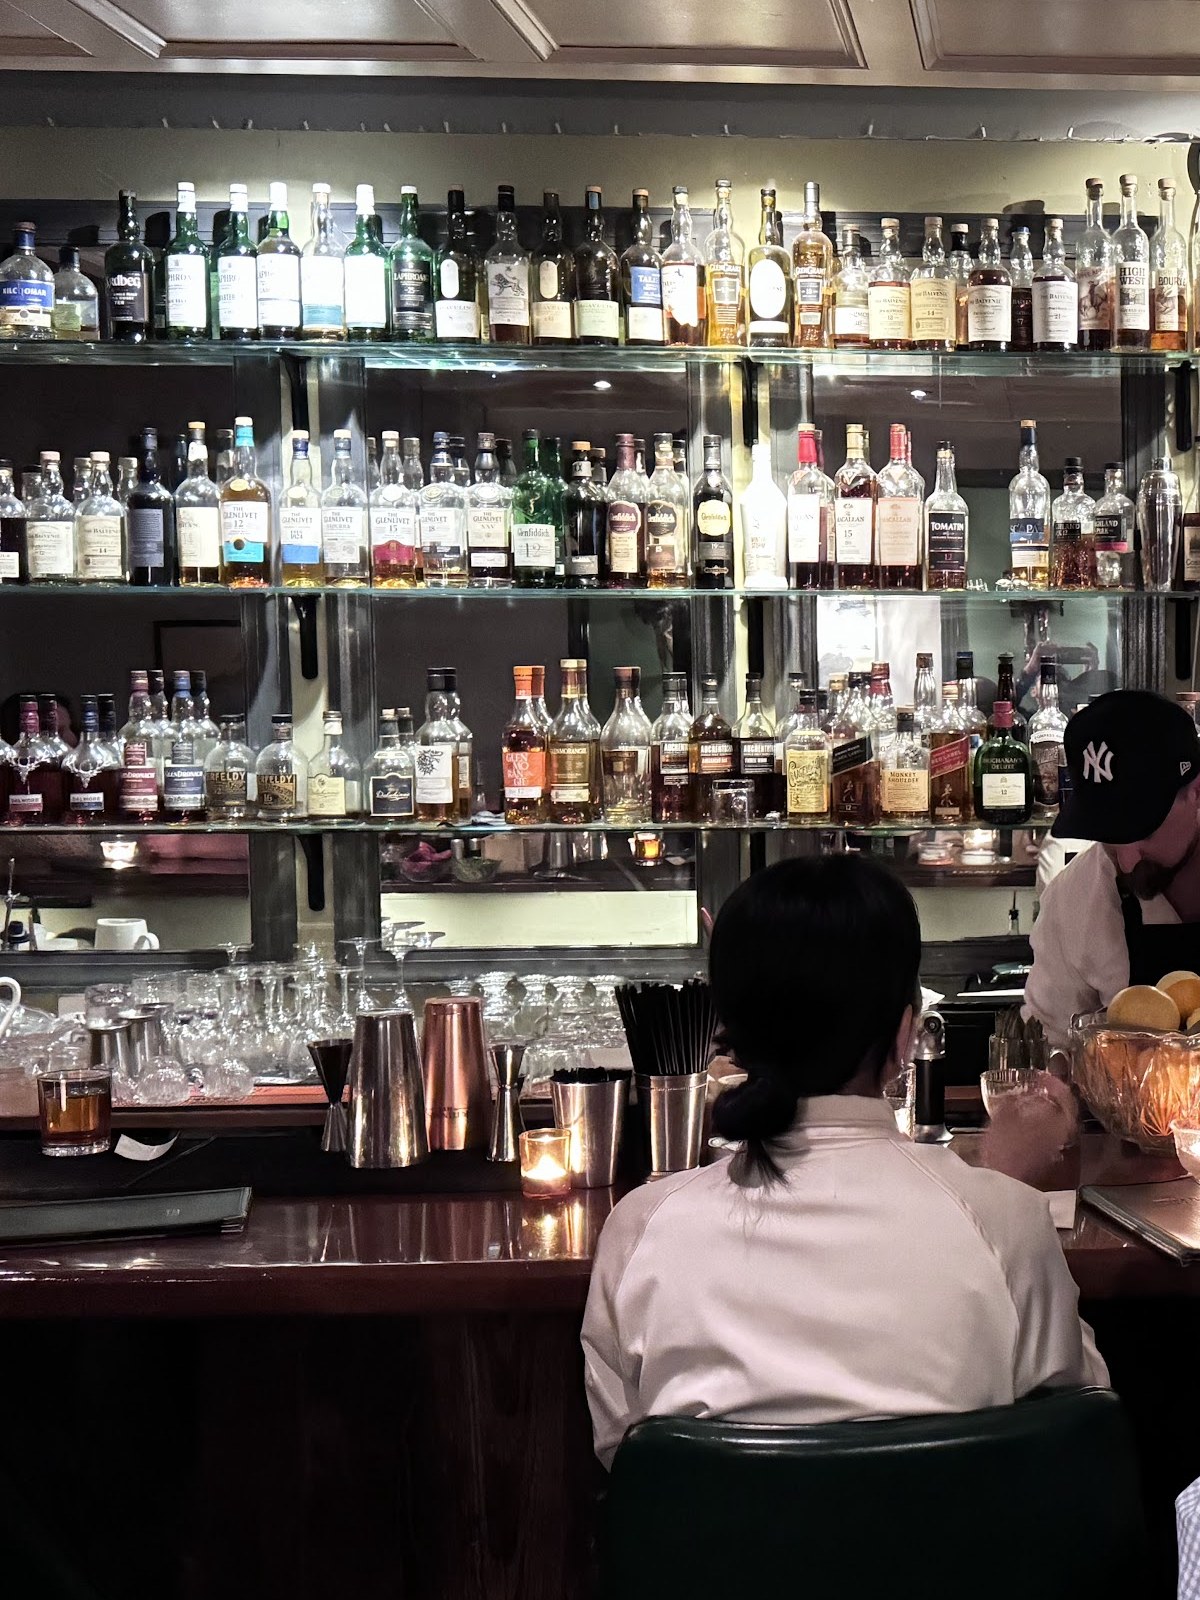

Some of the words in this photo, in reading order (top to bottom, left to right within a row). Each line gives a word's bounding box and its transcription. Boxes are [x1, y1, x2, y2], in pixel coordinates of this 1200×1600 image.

[1119, 267, 1146, 276] HIGH
[1119, 277, 1146, 286] WEST
[224, 512, 258, 520] GLENLIVET
[234, 519, 244, 528] 12
[375, 517, 410, 525] GLENLIVET
[931, 521, 965, 532] TOMATIN
[516, 527, 550, 538] Glenfiddich
[1083, 741, 1115, 784] NY
[1001, 788, 1008, 796] 12
